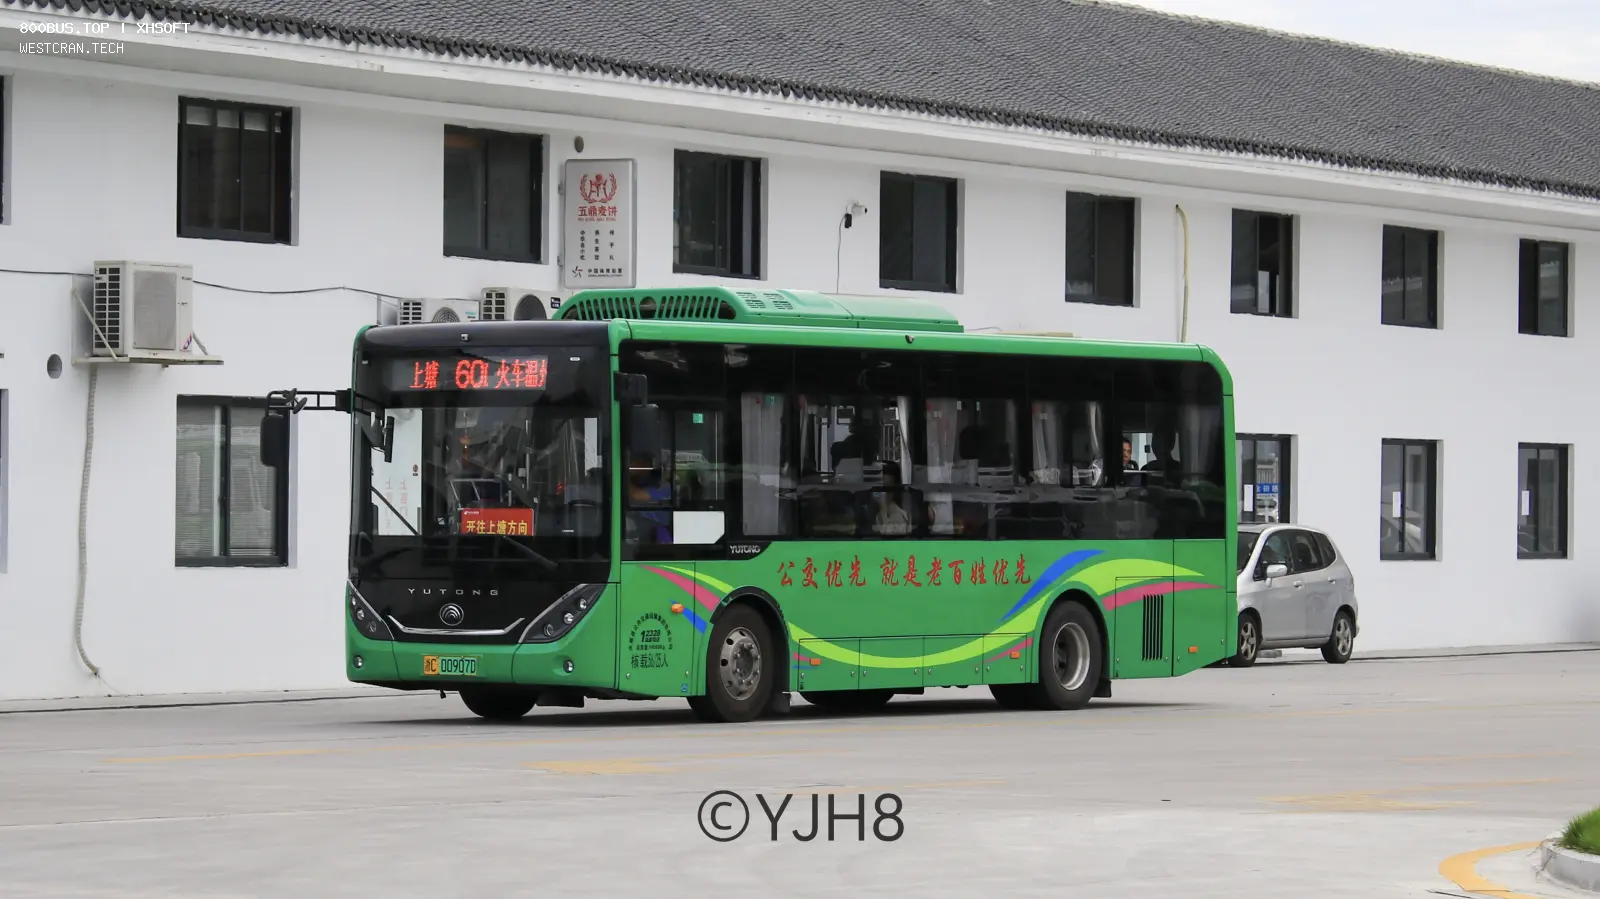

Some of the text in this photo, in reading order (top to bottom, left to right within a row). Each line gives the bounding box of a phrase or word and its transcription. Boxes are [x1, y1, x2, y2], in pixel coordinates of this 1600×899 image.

[409, 360, 439, 388] 上塘
[466, 520, 528, 535] 开往上塘方向
[730, 545, 760, 554] YUTONG
[776, 553, 1032, 589] 公交优先 就是老百姓优先
[408, 588, 499, 596] YUTONG
